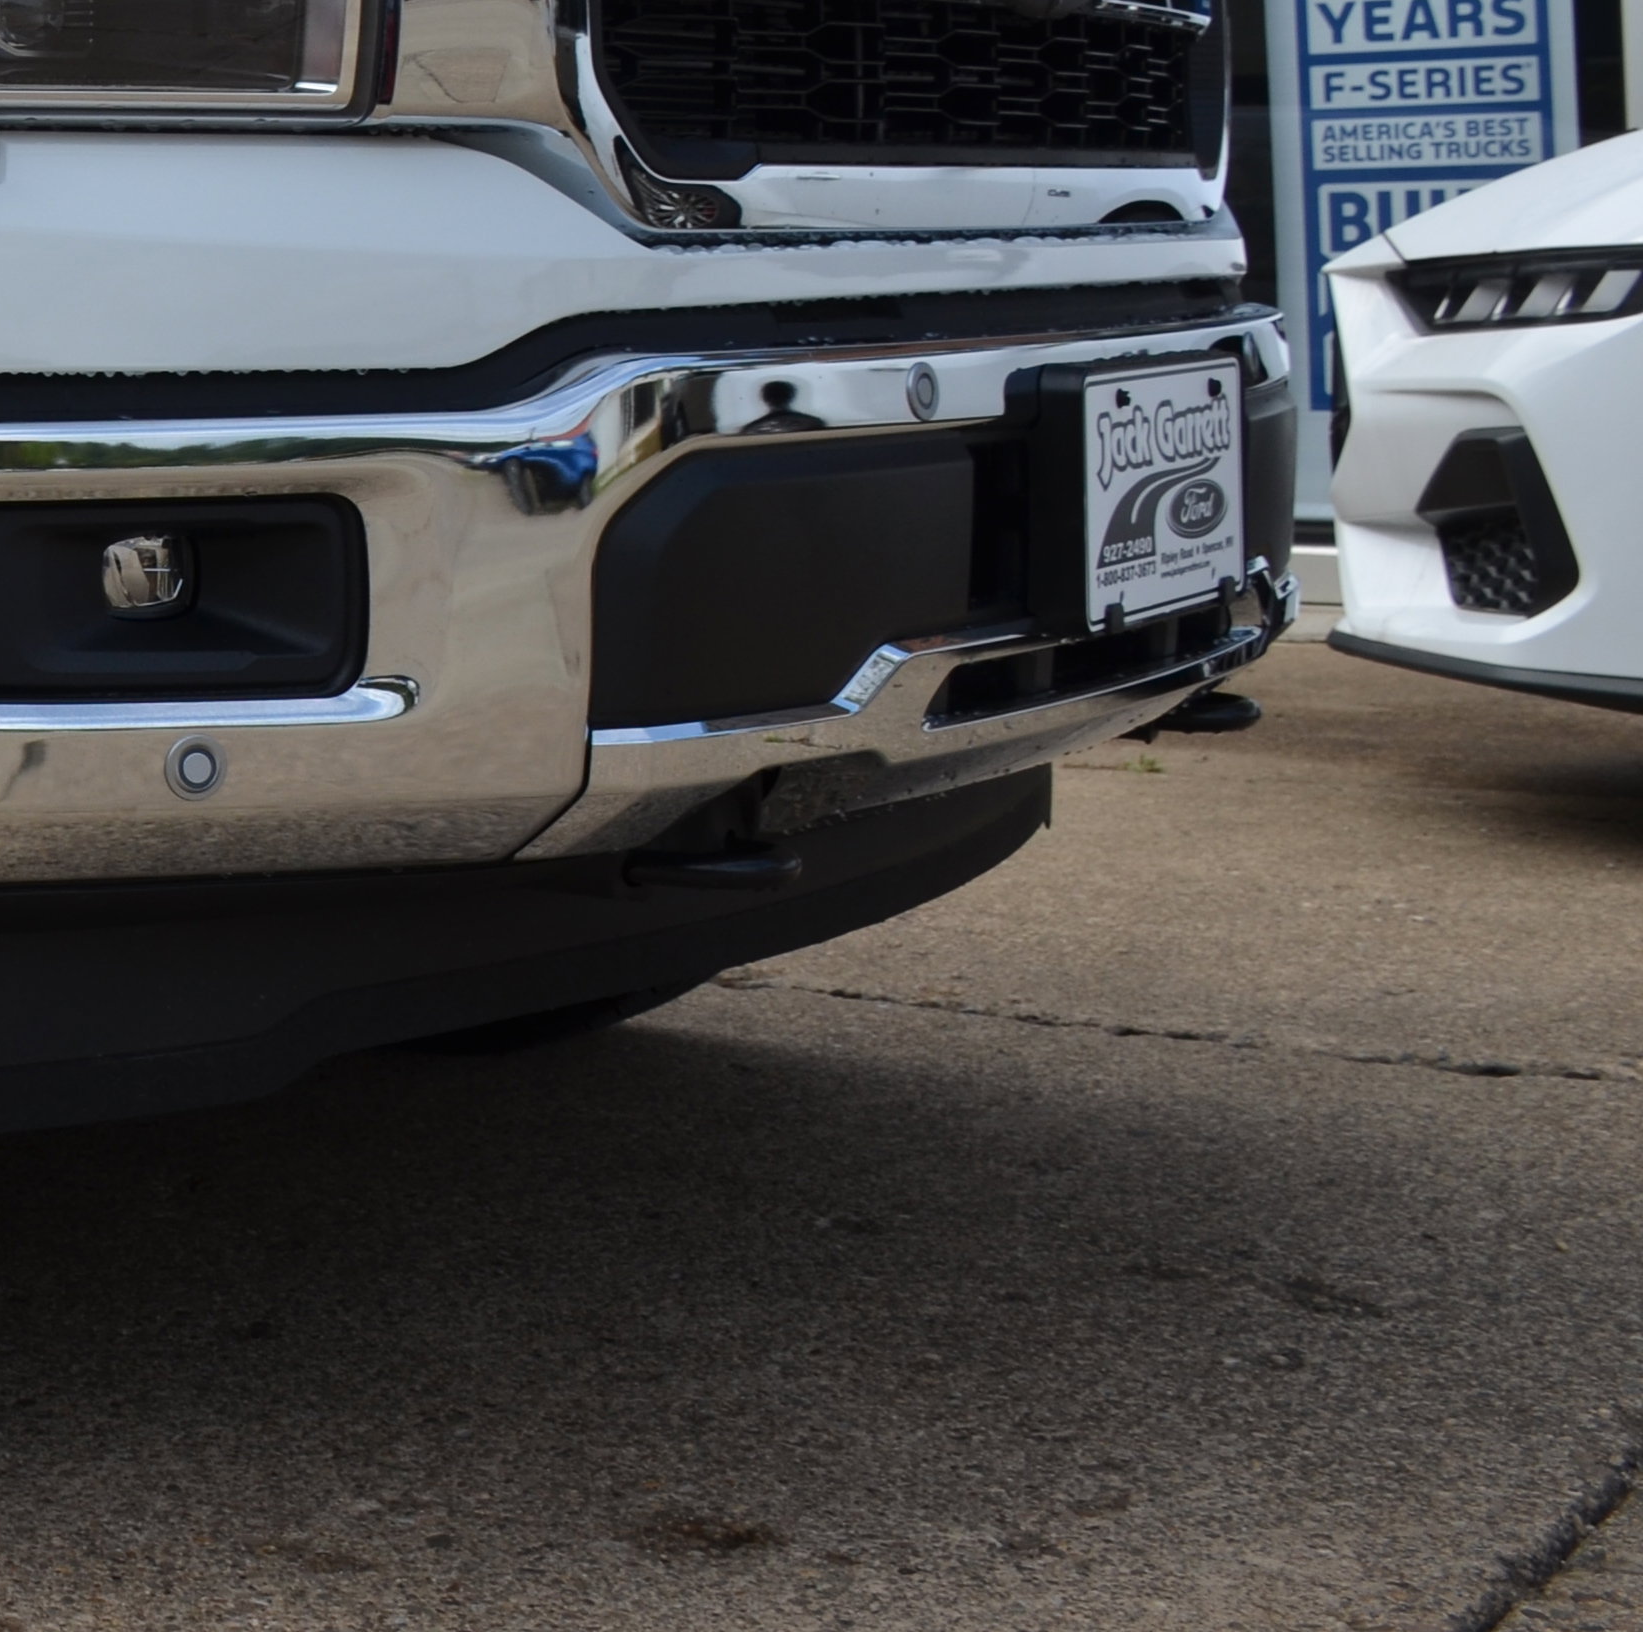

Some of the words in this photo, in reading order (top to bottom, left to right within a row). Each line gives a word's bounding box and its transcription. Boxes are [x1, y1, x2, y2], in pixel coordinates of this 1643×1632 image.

[1323, 63, 1527, 103] F-SERIES
[1322, 120, 1457, 143] AMERICA'S
[1465, 117, 1530, 138] BEST
[1322, 141, 1423, 164] SELLING
[1430, 139, 1532, 160] TRUCKS
[1096, 404, 1154, 492] Jack
[1155, 393, 1231, 463] Garrett
[1180, 487, 1215, 524] Ford
[1102, 535, 1153, 563] 927-2490
